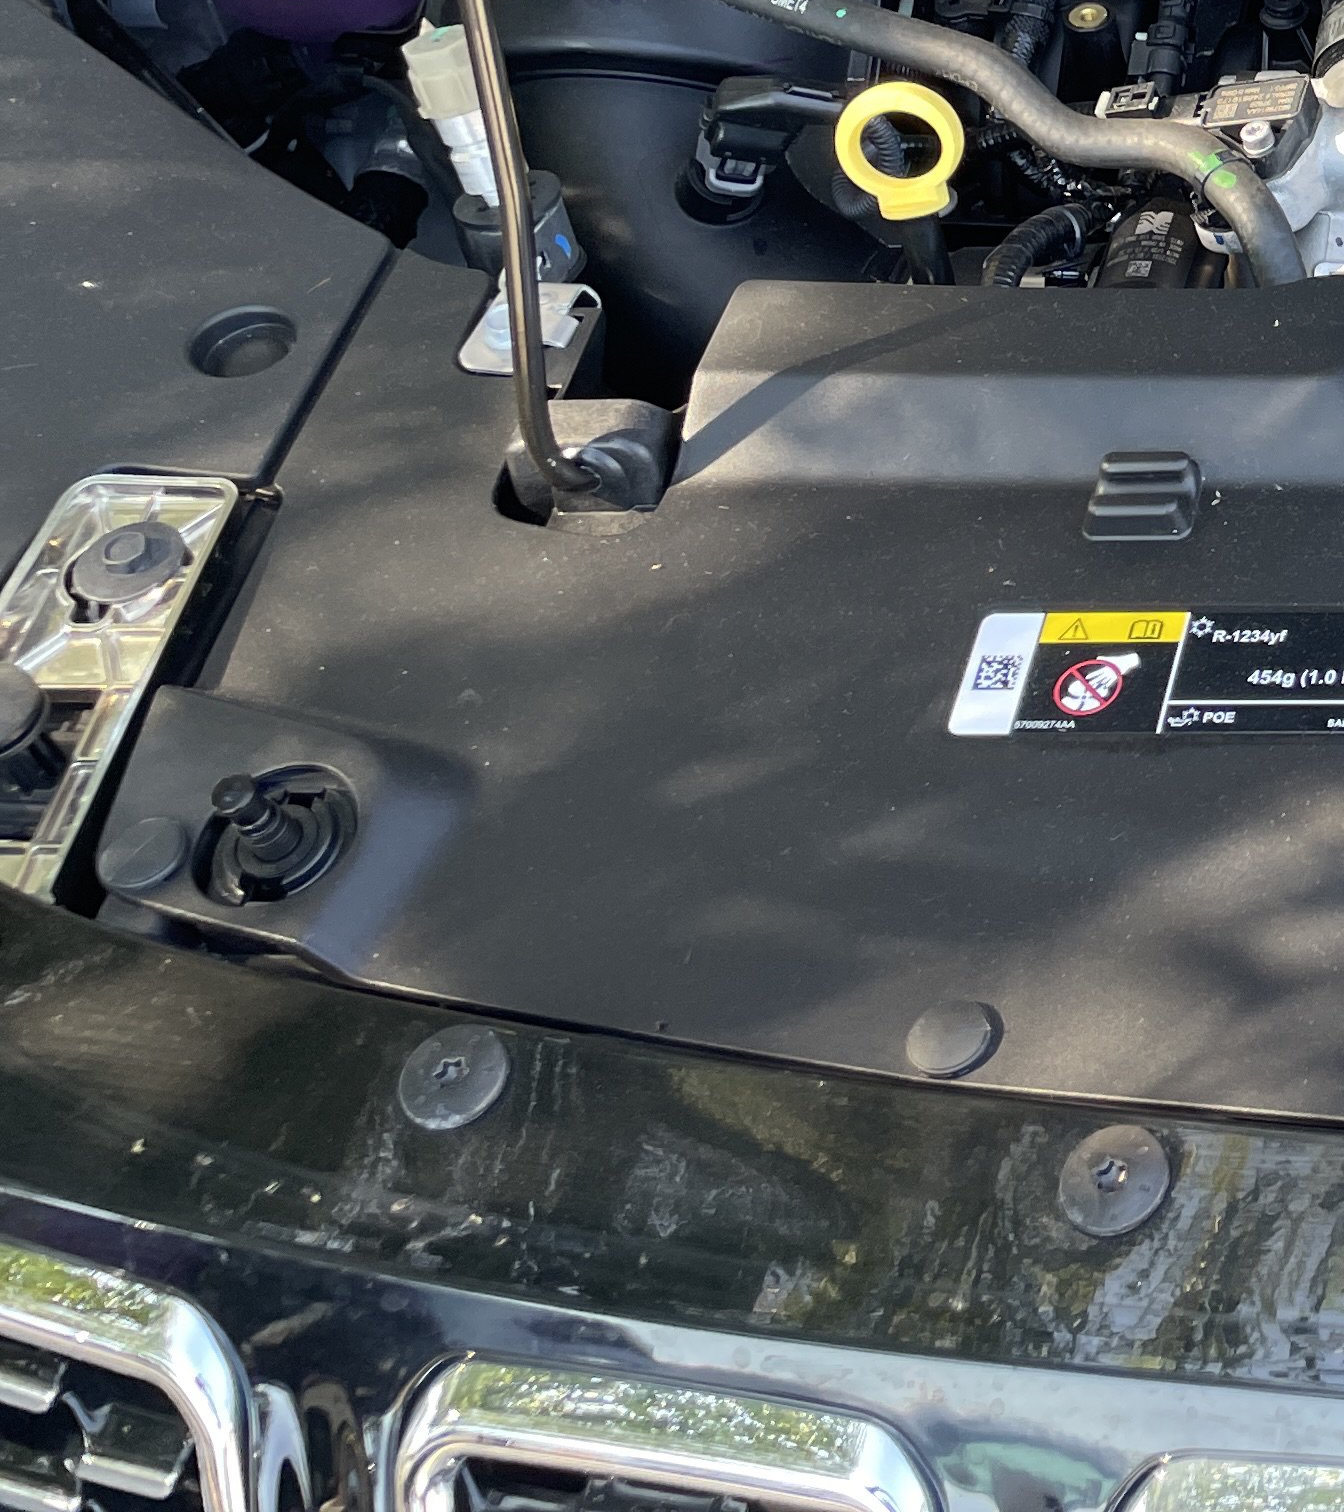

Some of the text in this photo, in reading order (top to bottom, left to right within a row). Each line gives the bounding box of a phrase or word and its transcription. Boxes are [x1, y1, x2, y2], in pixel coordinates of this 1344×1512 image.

[1212, 629, 1288, 646] R-1234yf
[1247, 669, 1297, 688] 454g
[1300, 669, 1337, 688] (1.0
[1202, 711, 1236, 724] POE
